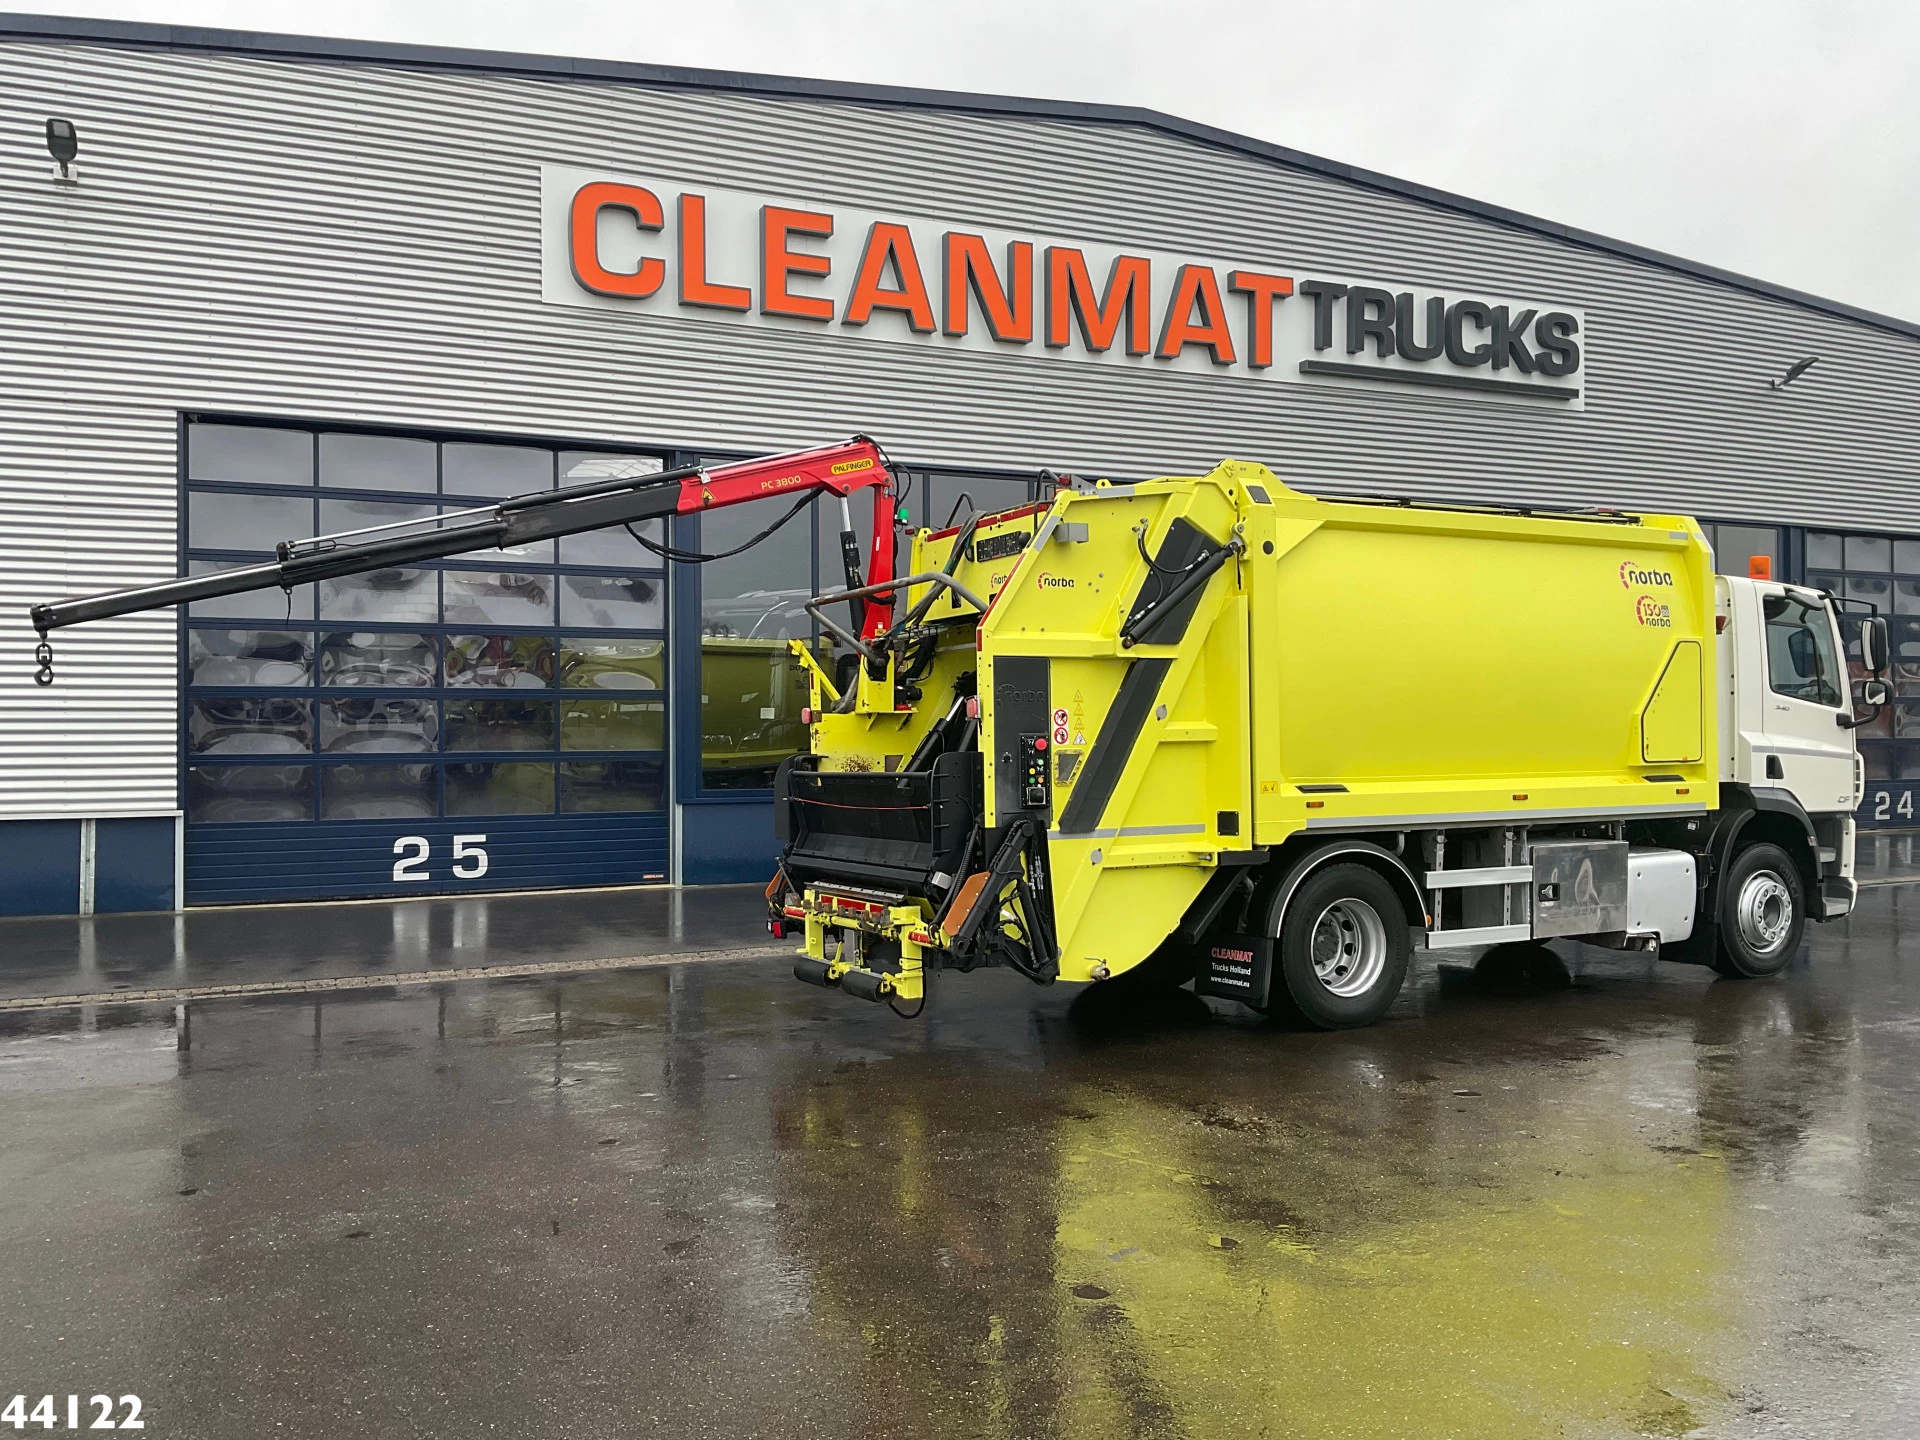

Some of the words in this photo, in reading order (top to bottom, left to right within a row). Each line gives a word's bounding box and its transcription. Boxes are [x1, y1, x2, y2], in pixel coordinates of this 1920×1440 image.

[568, 181, 1294, 369] CLEANMAT
[1300, 279, 1580, 376] TRUCKS
[833, 460, 871, 473] PALFINGER
[761, 481, 774, 490] PC
[776, 475, 802, 488] 3800
[994, 575, 1007, 585] norb
[1044, 577, 1075, 588] norba
[1628, 569, 1673, 586] norba
[1643, 603, 1661, 617] 150
[1646, 617, 1671, 627] norba
[1875, 790, 1914, 820] 24
[1211, 947, 1254, 963] CLEANMAT
[1211, 962, 1229, 972] Trucks
[1229, 965, 1252, 976] Holland
[1210, 976, 1250, 988] www.cleanmat.eu
